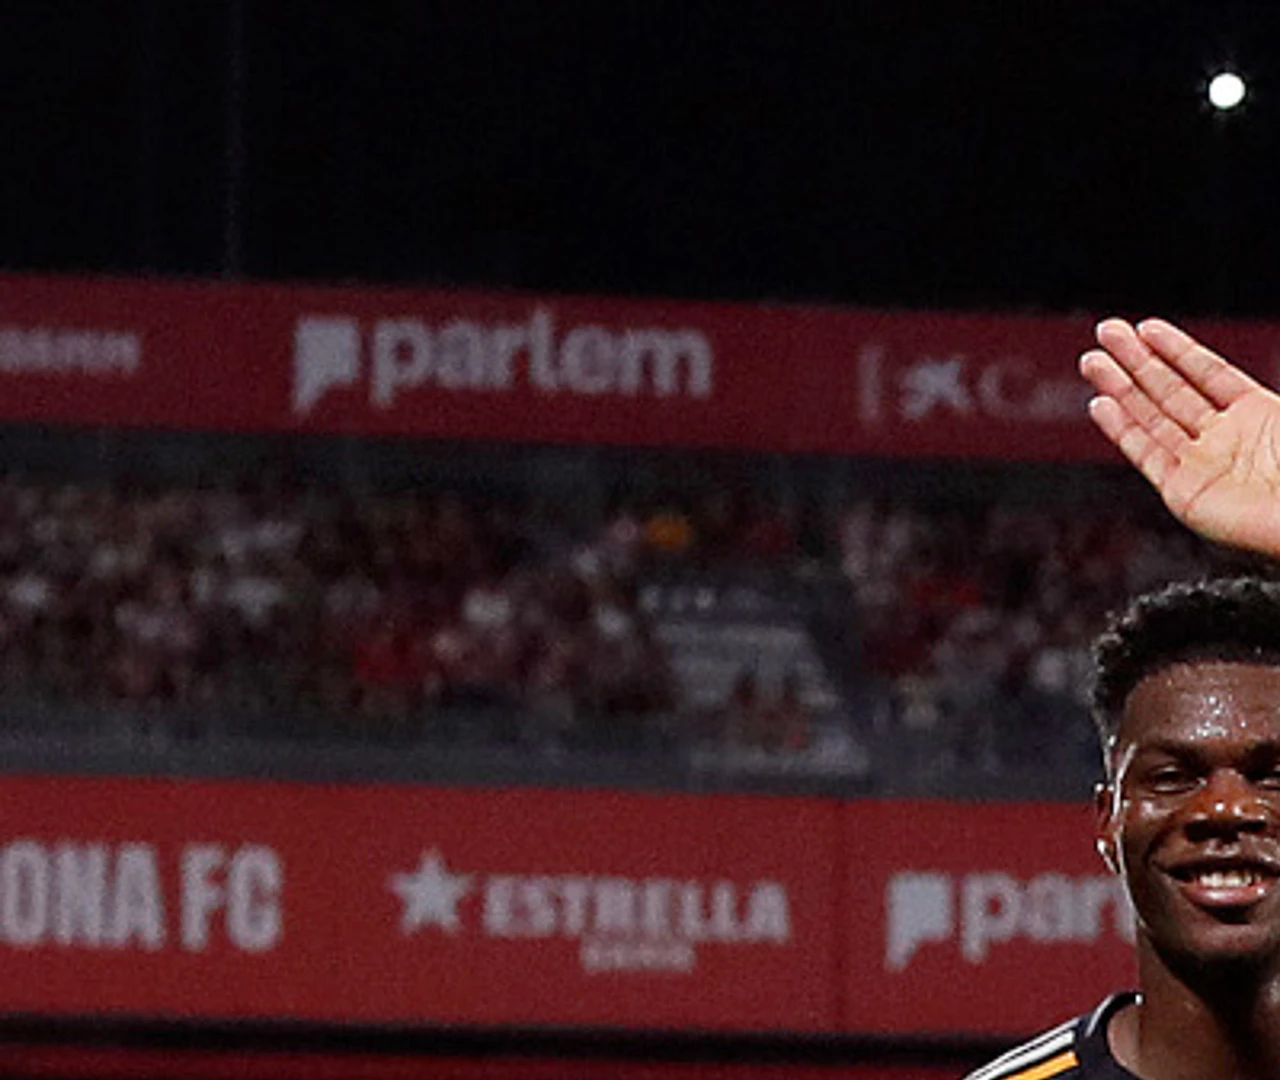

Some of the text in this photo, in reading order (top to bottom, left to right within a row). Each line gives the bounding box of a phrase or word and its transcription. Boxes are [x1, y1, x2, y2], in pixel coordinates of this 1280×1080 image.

[370, 310, 712, 405] parlem
[182, 843, 285, 953] FC
[482, 874, 790, 943] ESTRELLA
